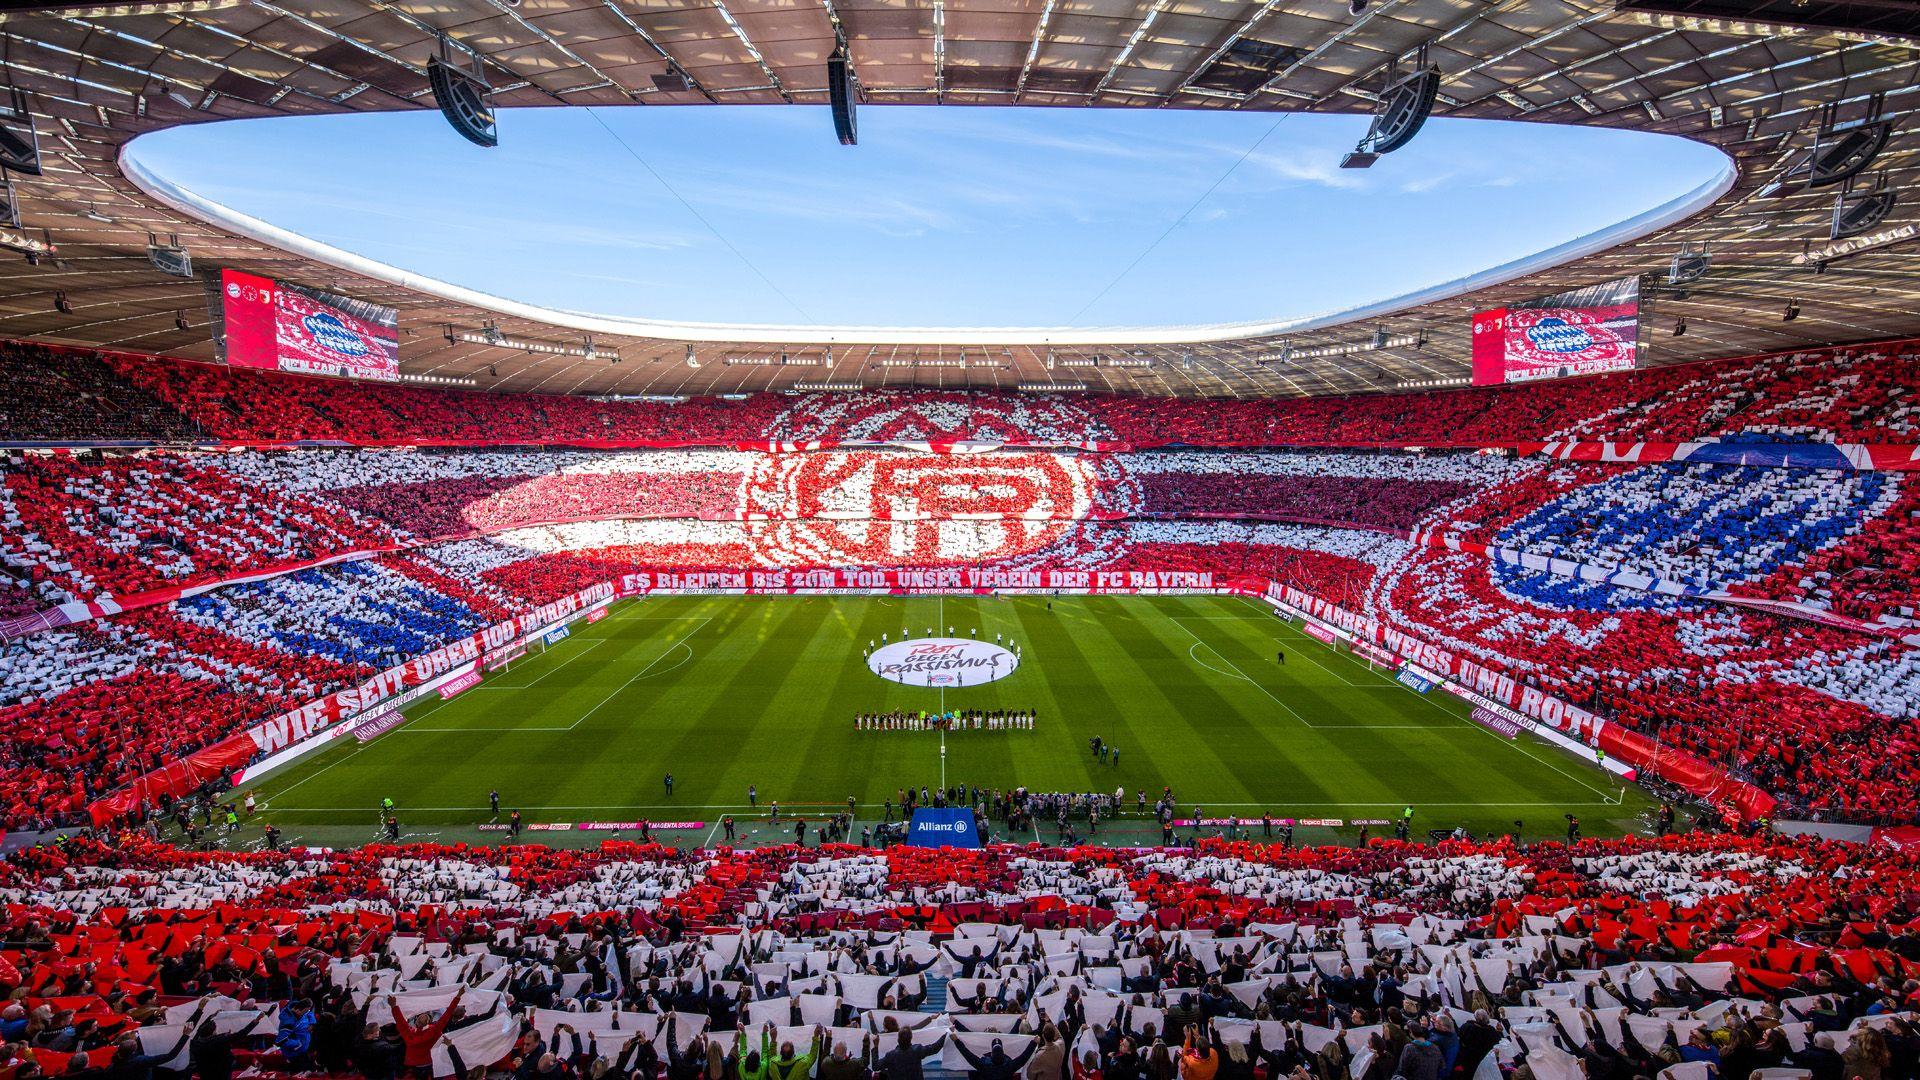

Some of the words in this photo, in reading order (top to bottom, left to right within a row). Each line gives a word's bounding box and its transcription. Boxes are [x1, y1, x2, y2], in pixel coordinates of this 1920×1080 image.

[622, 573, 650, 590] ES
[752, 572, 786, 588] BIS
[792, 571, 836, 587] ZUM
[844, 571, 890, 587] TOD.
[898, 571, 961, 587] UNSER
[968, 571, 1041, 587] VEREIN
[1050, 571, 1089, 587] DER
[1097, 571, 1123, 587] FC
[1130, 571, 1212, 587] BAYERN
[493, 642, 516, 659] BAYERN
[904, 649, 964, 663] GEGEN
[910, 643, 971, 656] ROT
[249, 699, 328, 753] WIE
[337, 664, 406, 718] SEIT
[481, 620, 514, 652] 100
[518, 594, 576, 633] JAHREN
[578, 581, 614, 607] WIRD
[881, 653, 1006, 674] RASSISMUS
[1268, 580, 1282, 600] IN
[1286, 585, 1314, 612] DEN
[1314, 597, 1380, 643] FARBEN
[1384, 627, 1453, 676] WEISS
[1459, 659, 1515, 705] UND
[1519, 686, 1605, 747] ROT!
[1470, 694, 1494, 710] GEGEN
[332, 718, 352, 738] ROT
[354, 707, 380, 727] GEGEN
[354, 720, 379, 741] QATAR
[378, 709, 403, 731] AIRWAYS
[1471, 707, 1494, 726] QATAR
[1492, 715, 1521, 736] AIRWAYS
[918, 822, 953, 831] Allianz
